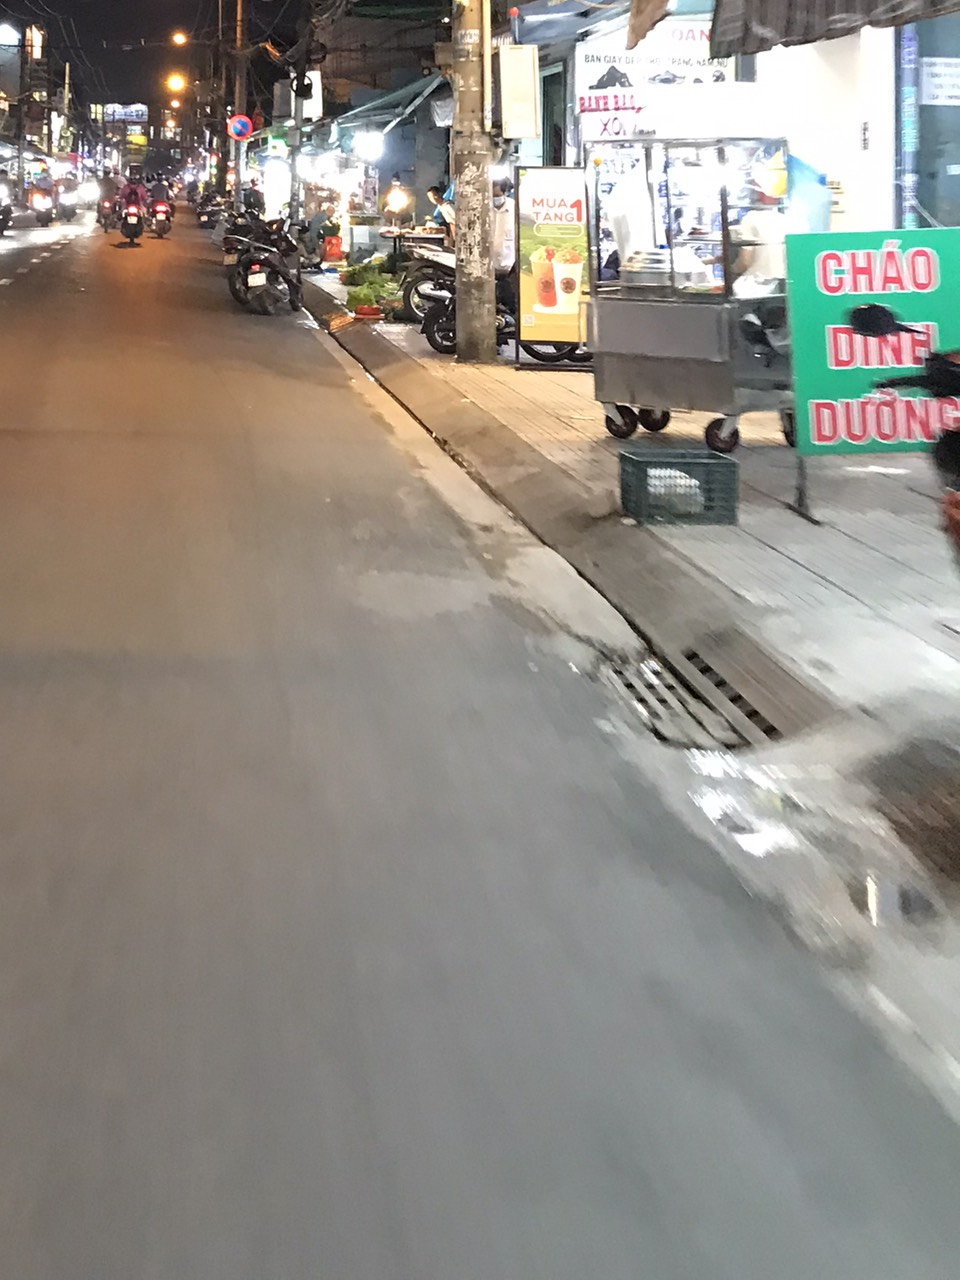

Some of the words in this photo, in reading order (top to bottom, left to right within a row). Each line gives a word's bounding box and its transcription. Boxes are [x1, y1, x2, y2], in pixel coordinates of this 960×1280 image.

[532, 198, 567, 208] MUA
[570, 199, 582, 222] 1
[815, 239, 940, 295] CHÁO
